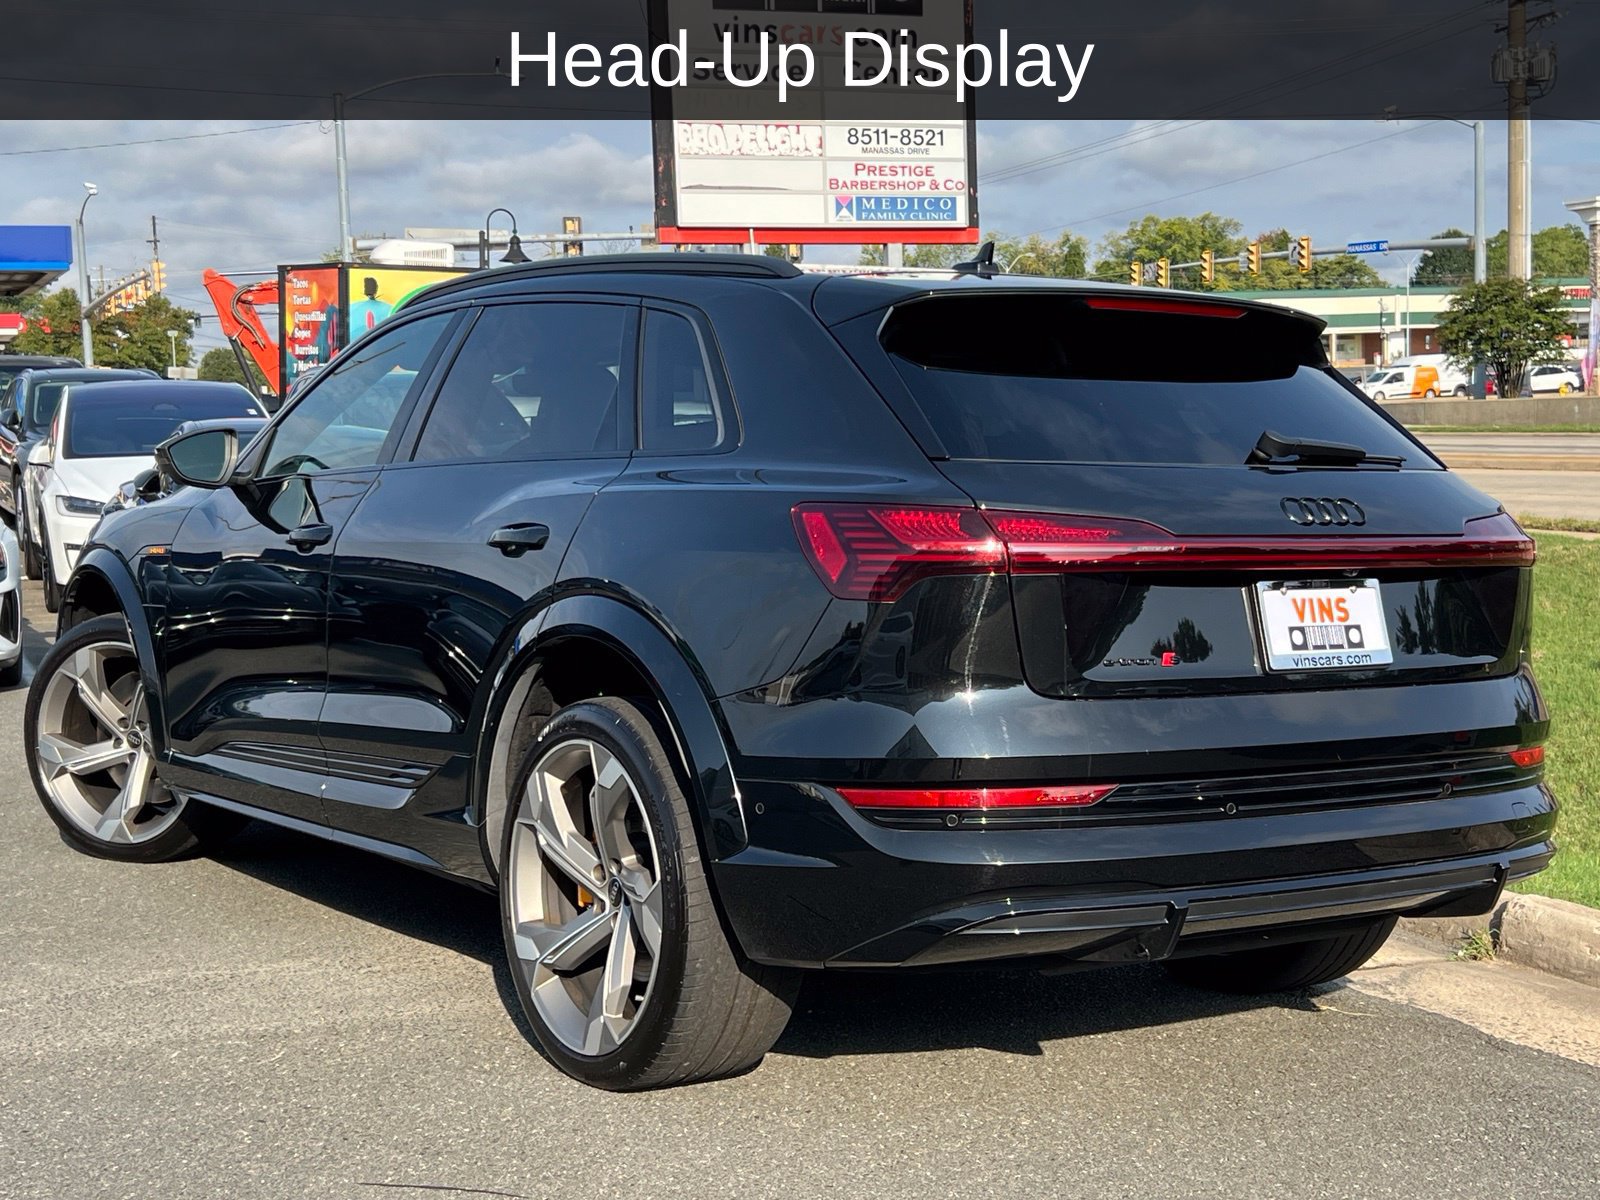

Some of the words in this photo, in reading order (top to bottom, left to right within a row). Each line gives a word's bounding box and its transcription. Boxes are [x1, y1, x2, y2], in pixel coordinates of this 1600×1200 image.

[712, 16, 918, 49] vinscarscom
[692, 56, 804, 83] Servce
[847, 127, 944, 146] 8511-8521
[861, 146, 905, 155] MANASSAS
[907, 147, 930, 155] DRIVE
[854, 163, 935, 177] PRESTIGE
[828, 178, 926, 191] BARBERSHOP
[929, 179, 940, 191] &
[861, 197, 952, 210] MEDICO
[861, 211, 907, 220] FAMILY
[909, 211, 952, 220] CLINIC
[292, 278, 309, 289] Tacos
[292, 294, 312, 305] Tortas
[1291, 597, 1350, 623] VINS
[1292, 653, 1372, 667] vinscars.com
